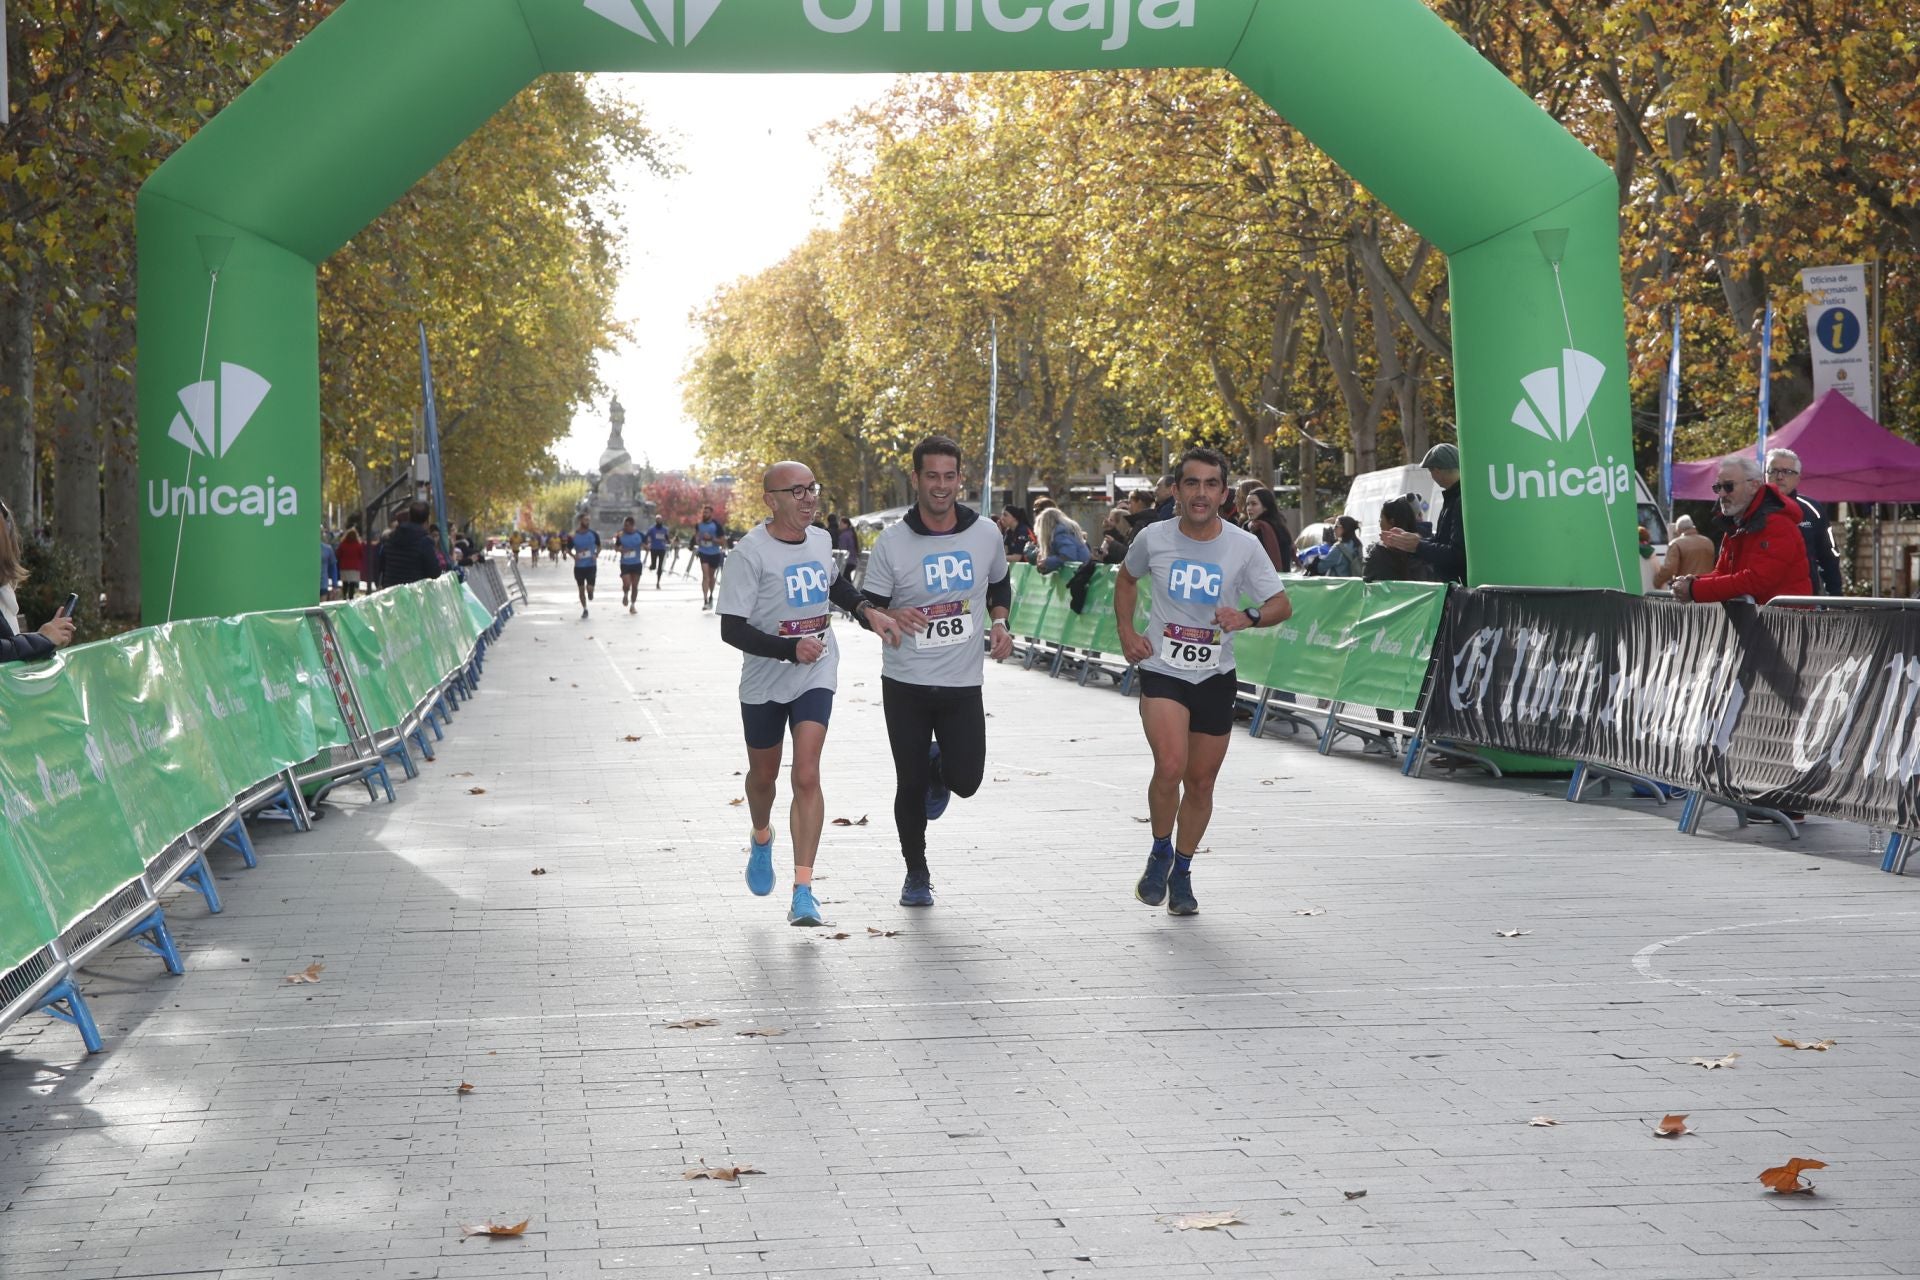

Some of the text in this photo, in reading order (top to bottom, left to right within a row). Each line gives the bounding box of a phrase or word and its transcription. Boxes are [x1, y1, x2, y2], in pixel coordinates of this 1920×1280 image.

[1810, 274, 1848, 284] Oficina de
[1488, 456, 1630, 505] Unicaja
[148, 475, 298, 527] Unicaja
[785, 566, 828, 603] PPG
[925, 555, 973, 591] PPG
[1169, 564, 1221, 599] PPG
[926, 617, 964, 640] 768
[1170, 641, 1212, 663] 769
